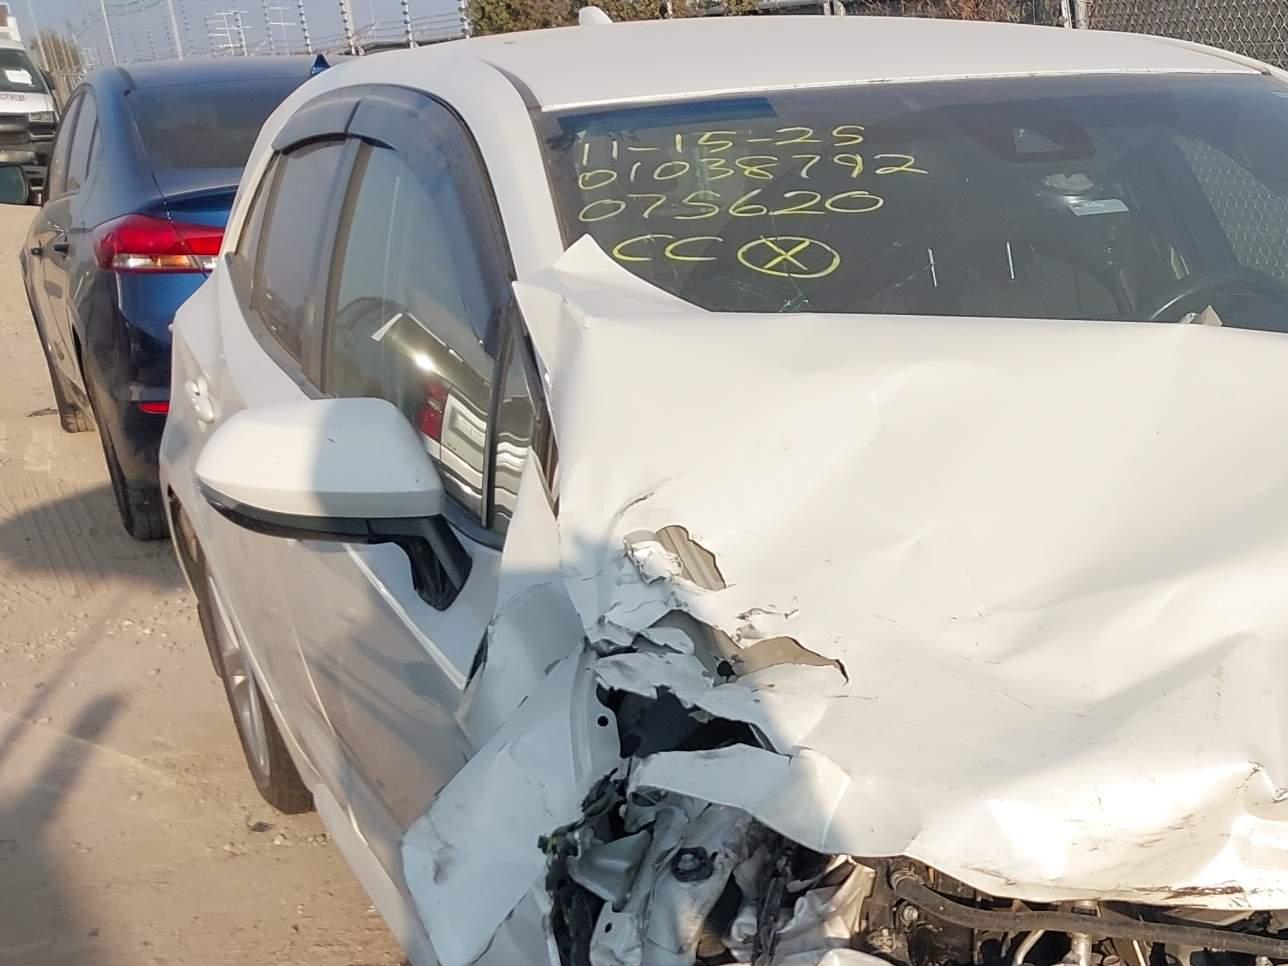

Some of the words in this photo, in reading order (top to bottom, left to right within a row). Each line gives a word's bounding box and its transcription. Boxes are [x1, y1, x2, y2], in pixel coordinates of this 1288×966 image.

[577, 154, 930, 190] 01038792
[577, 189, 884, 222] 075620
[612, 234, 724, 261] CC
